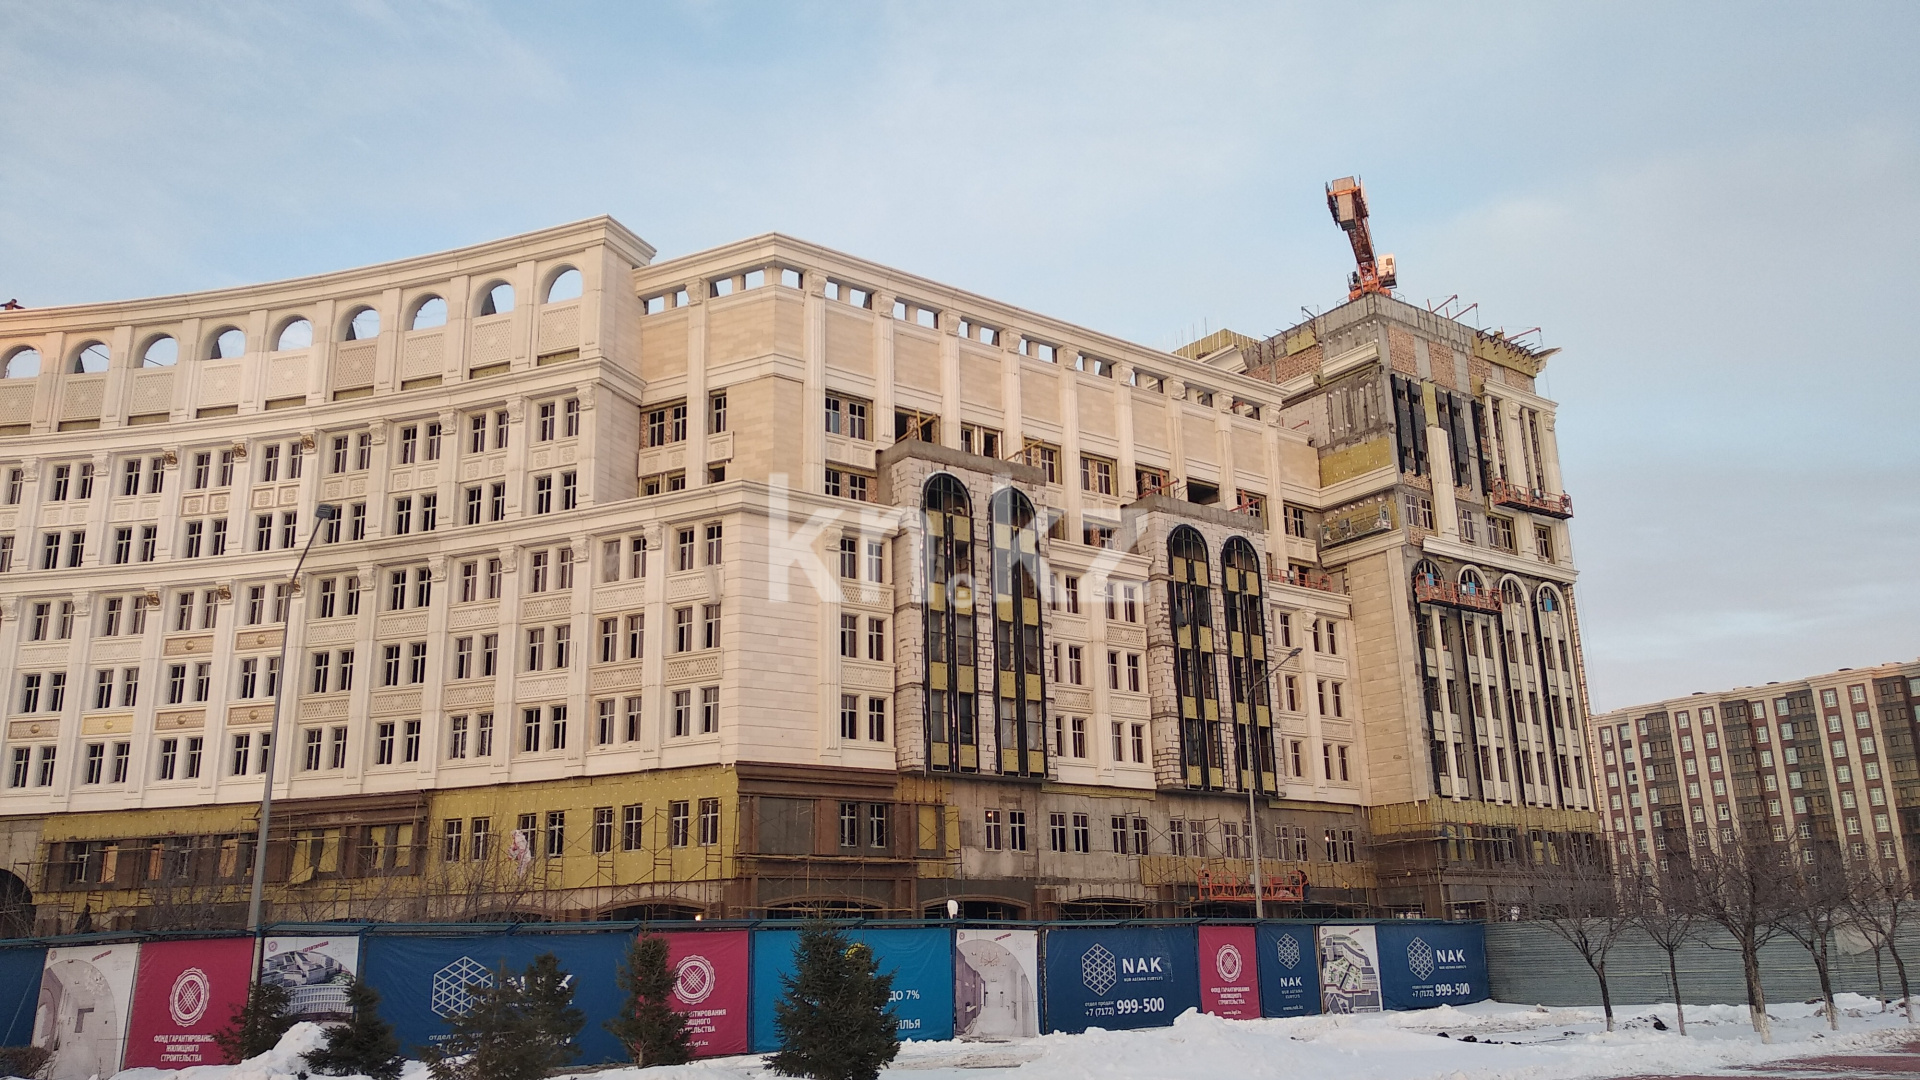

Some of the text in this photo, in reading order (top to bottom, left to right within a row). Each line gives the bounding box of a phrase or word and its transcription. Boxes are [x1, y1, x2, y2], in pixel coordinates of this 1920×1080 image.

[1436, 949, 1465, 963] NAK
[1122, 957, 1162, 974] NAK
[1280, 976, 1302, 987] NAK
[905, 990, 920, 1000] 7%
[1419, 990, 1434, 998] (7172)
[1435, 983, 1470, 996] 999-500
[1095, 1007, 1115, 1017] (7172)
[1116, 997, 1165, 1015] 999-500
[153, 1034, 168, 1043] ФОНД
[428, 1033, 451, 1041] отдел
[160, 1054, 202, 1062] СТРОИТЕЛЬСТВА
